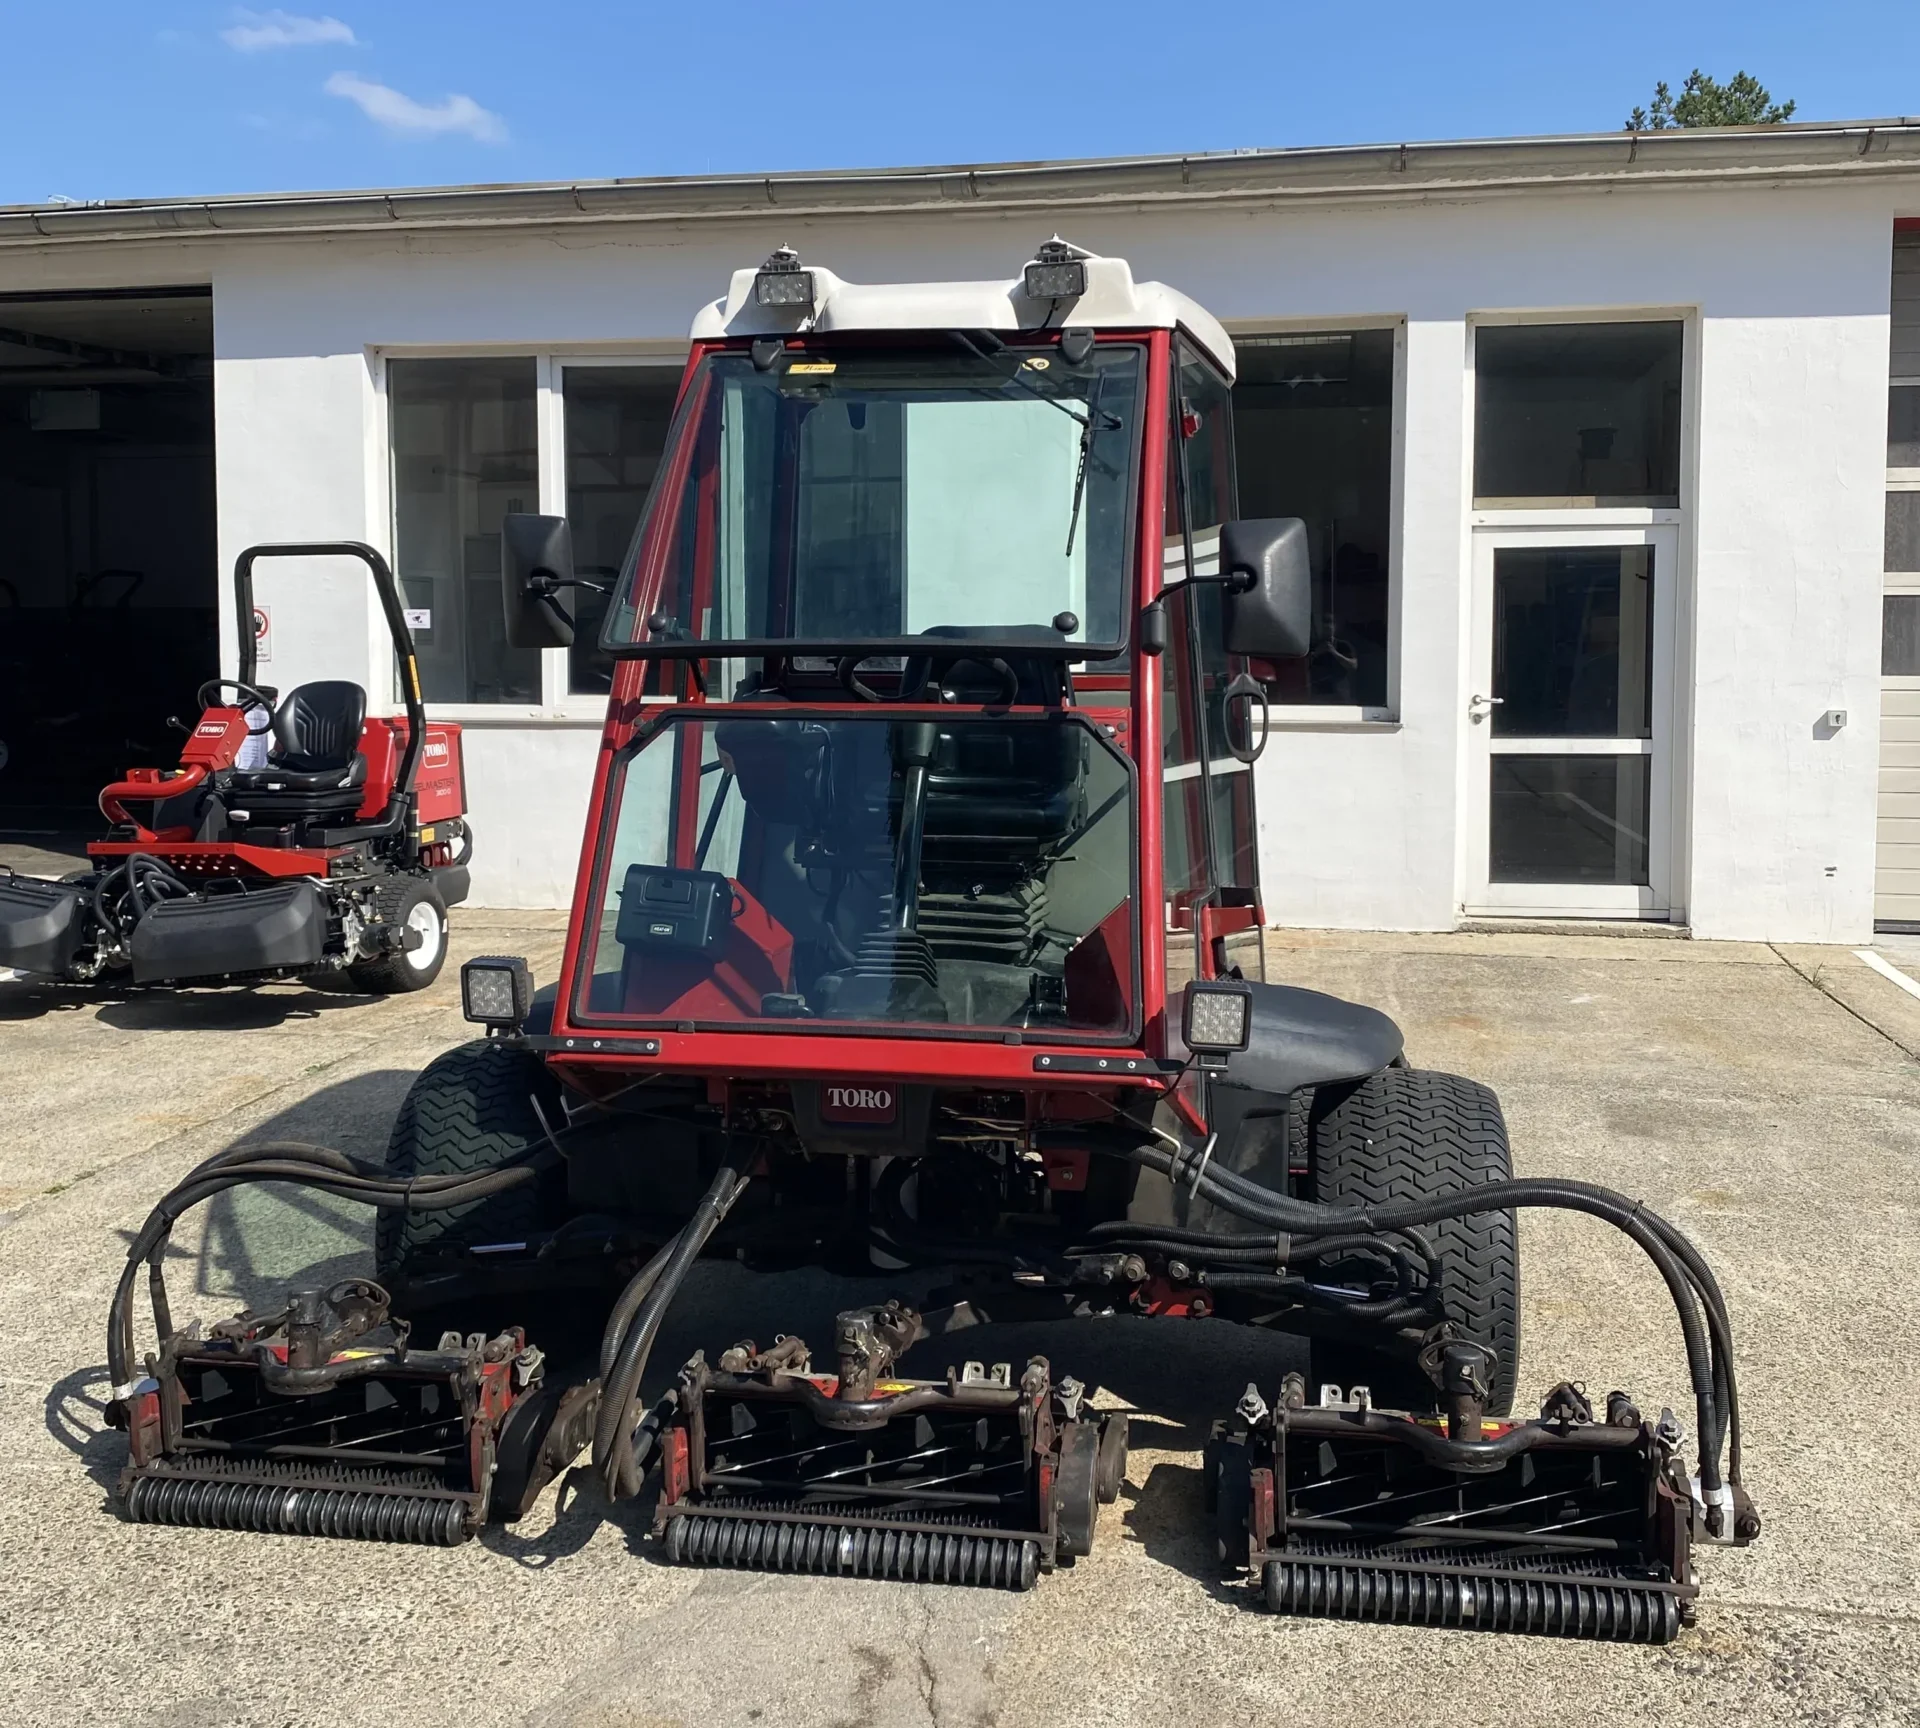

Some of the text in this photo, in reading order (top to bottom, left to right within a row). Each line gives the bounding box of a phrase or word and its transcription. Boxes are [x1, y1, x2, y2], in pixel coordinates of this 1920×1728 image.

[424, 743, 447, 757] TORO
[412, 777, 455, 792] EELMASTER
[828, 1088, 892, 1109] TORO
